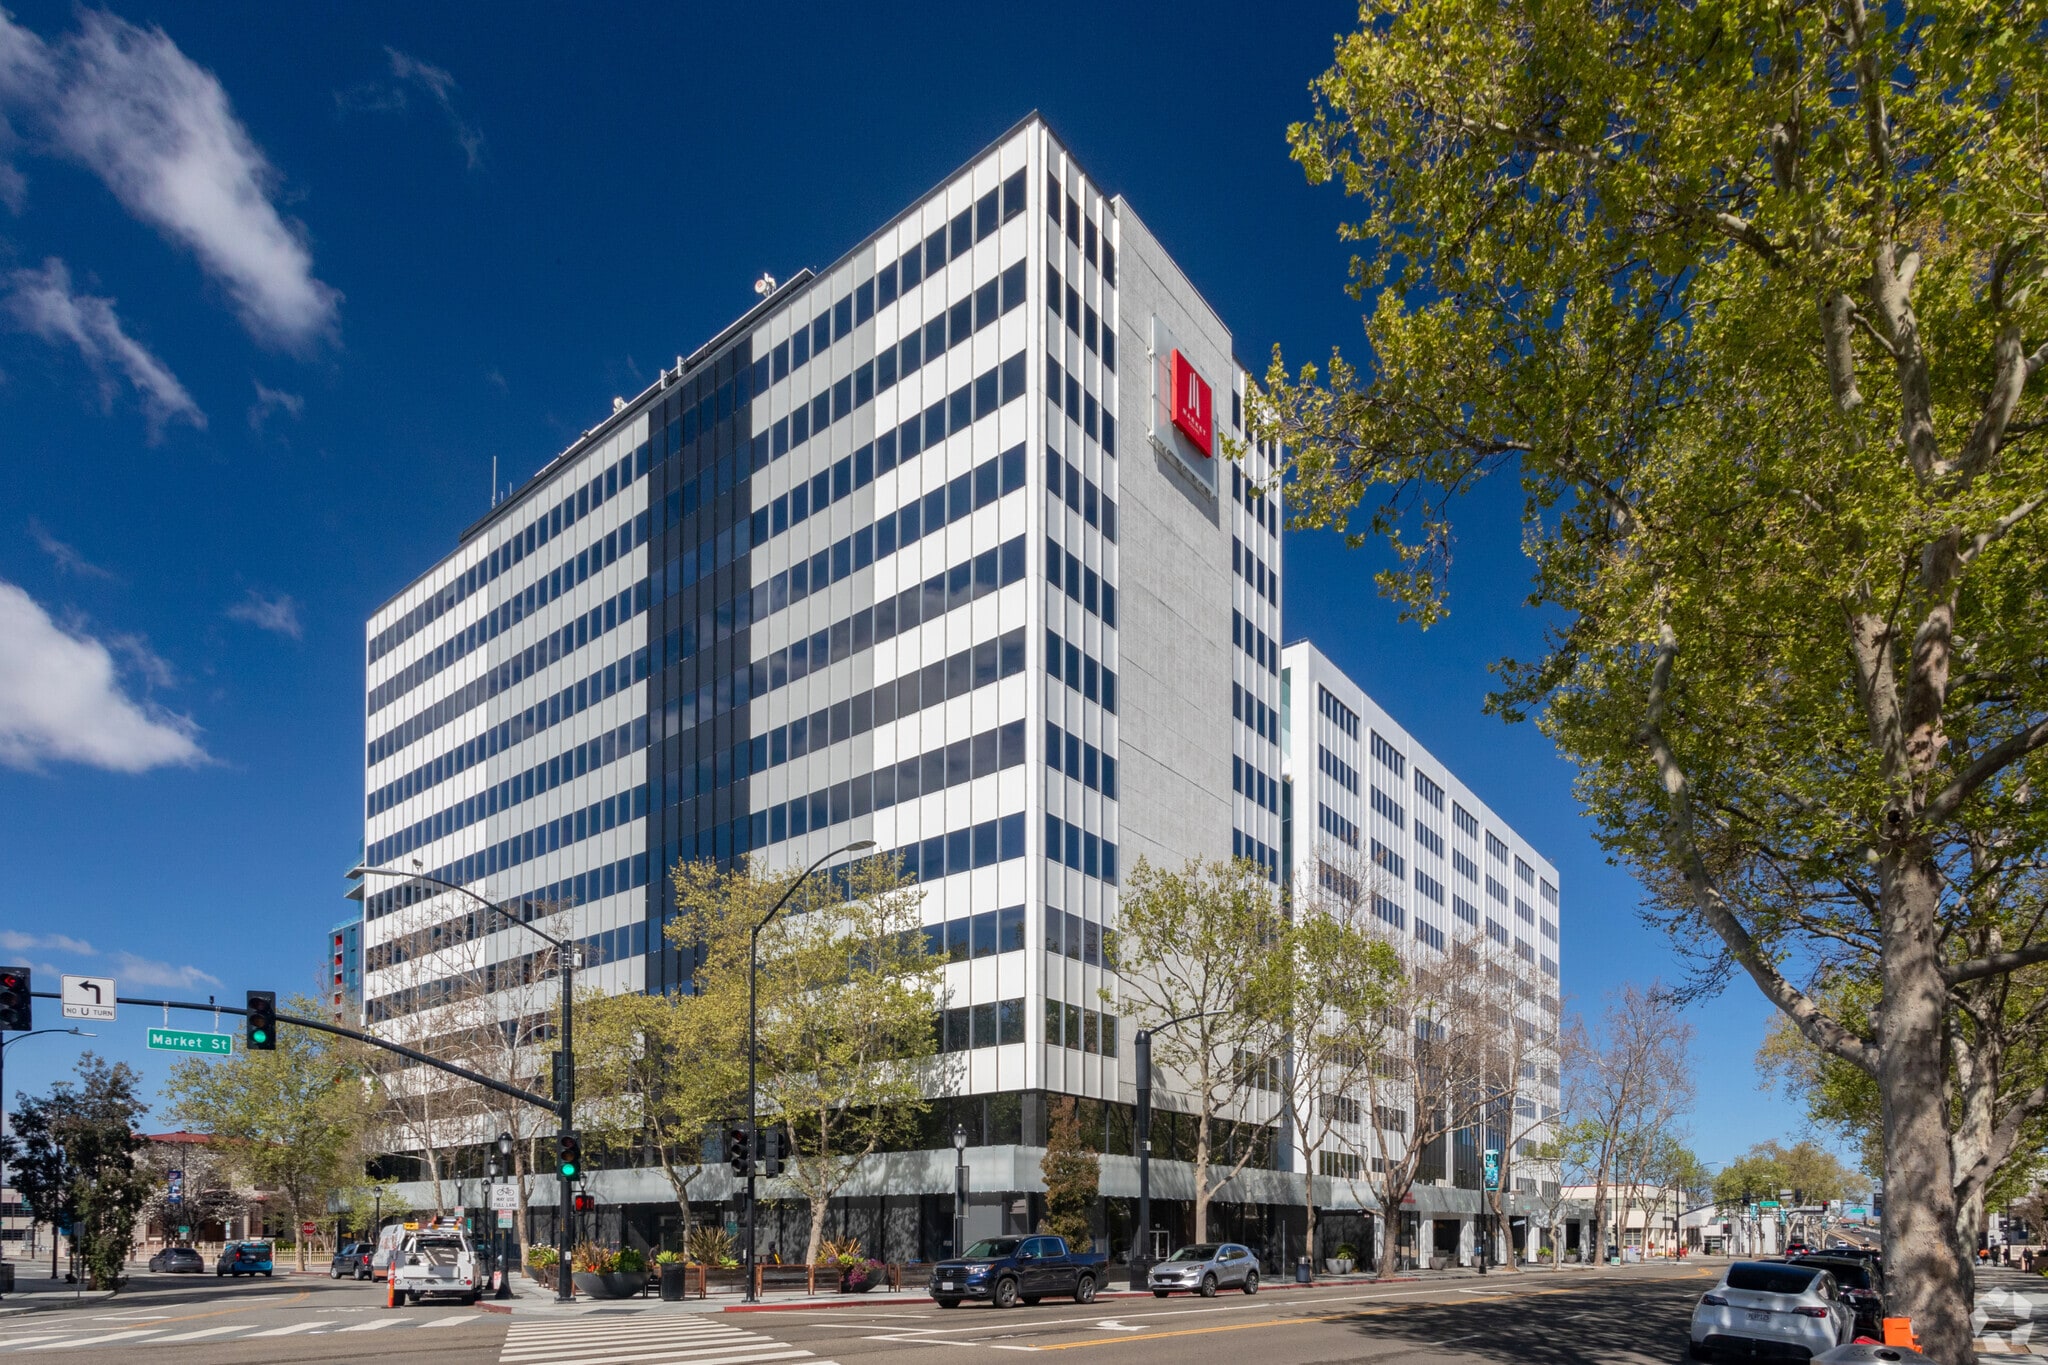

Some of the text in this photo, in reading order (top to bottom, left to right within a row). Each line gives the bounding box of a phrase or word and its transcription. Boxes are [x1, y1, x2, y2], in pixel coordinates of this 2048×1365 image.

[1182, 407, 1206, 436] MARKET
[66, 1007, 113, 1017] NO U TURN
[152, 1034, 227, 1050] Market St
